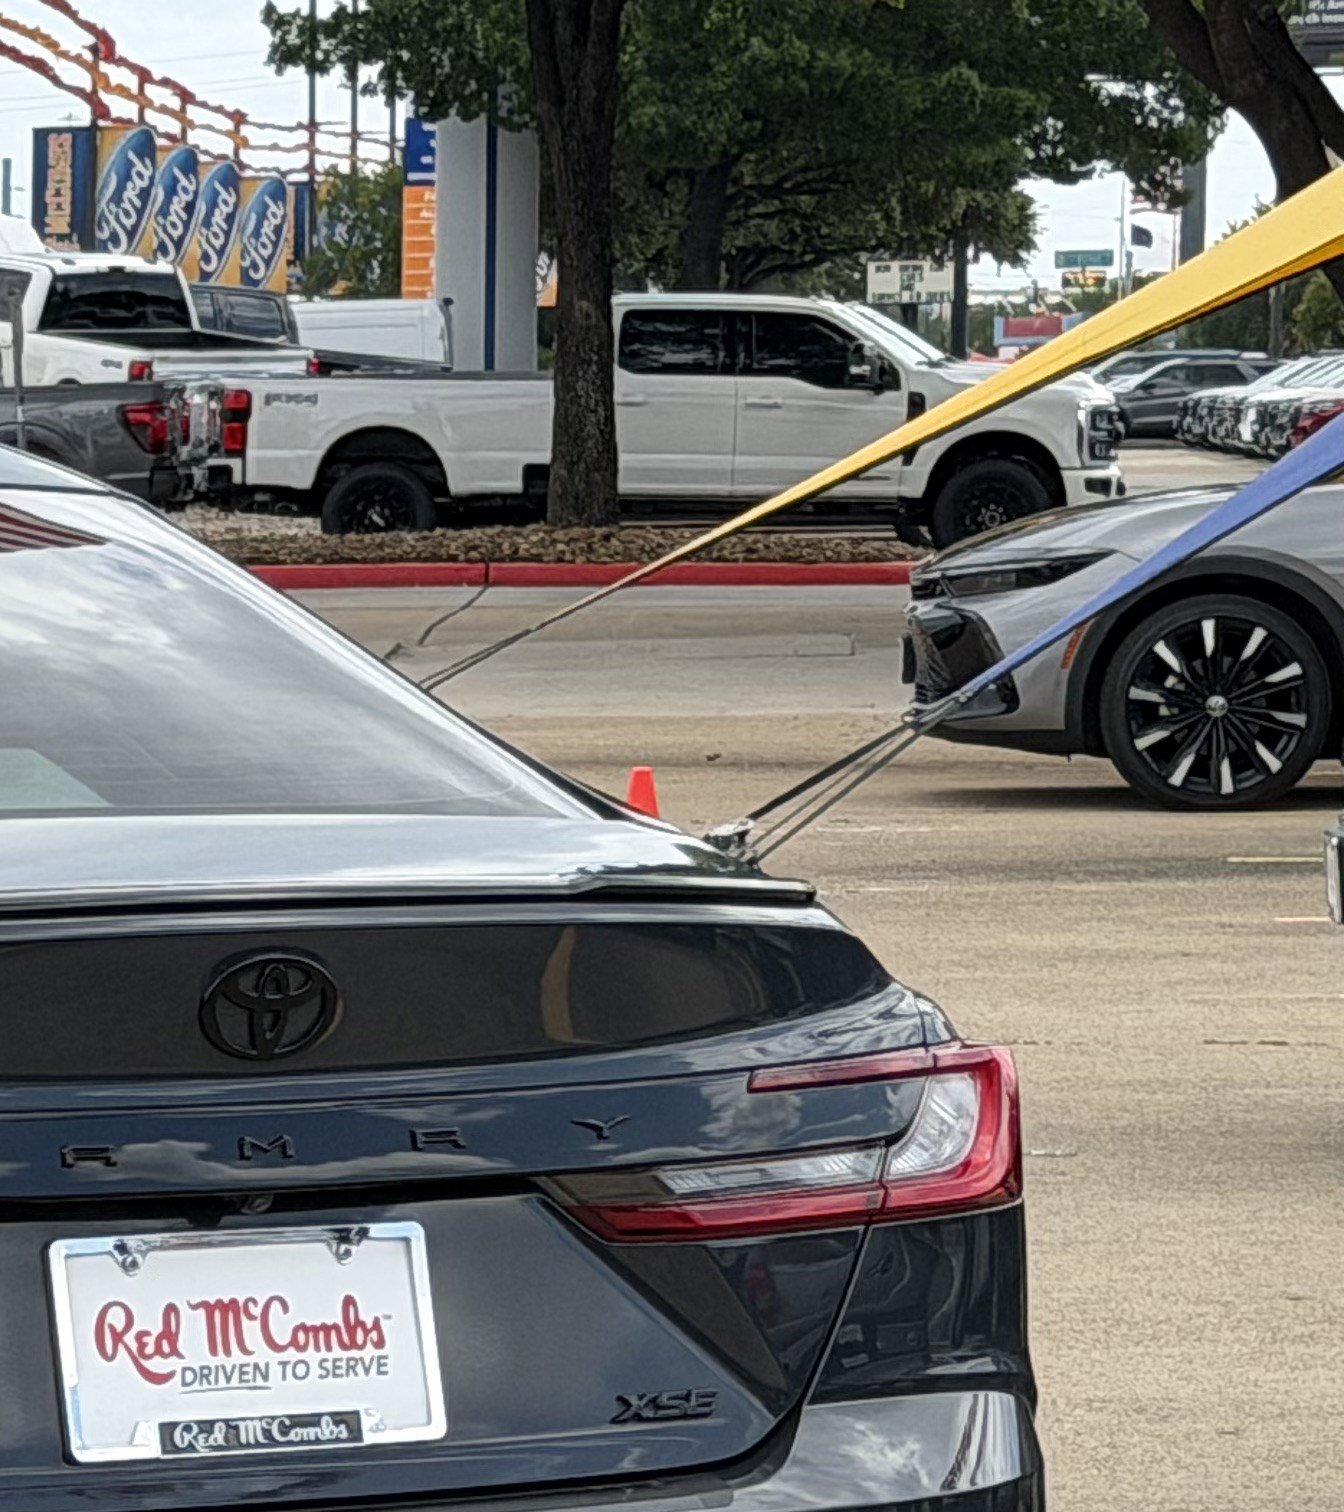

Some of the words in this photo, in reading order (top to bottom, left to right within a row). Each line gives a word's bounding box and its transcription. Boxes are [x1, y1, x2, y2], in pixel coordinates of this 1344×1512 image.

[95, 150, 154, 253] Ford
[153, 166, 198, 262] Ford
[197, 180, 237, 273] Ford
[240, 194, 285, 280] Ford
[95, 1300, 186, 1385] Red
[186, 1294, 387, 1358] McCombs
[180, 1361, 271, 1388] DRIVEN
[278, 1359, 311, 1382] TO
[317, 1354, 389, 1380] SERVE
[173, 1421, 228, 1452] Red
[227, 1415, 349, 1445] McCombs
[609, 1388, 718, 1424] XSE
